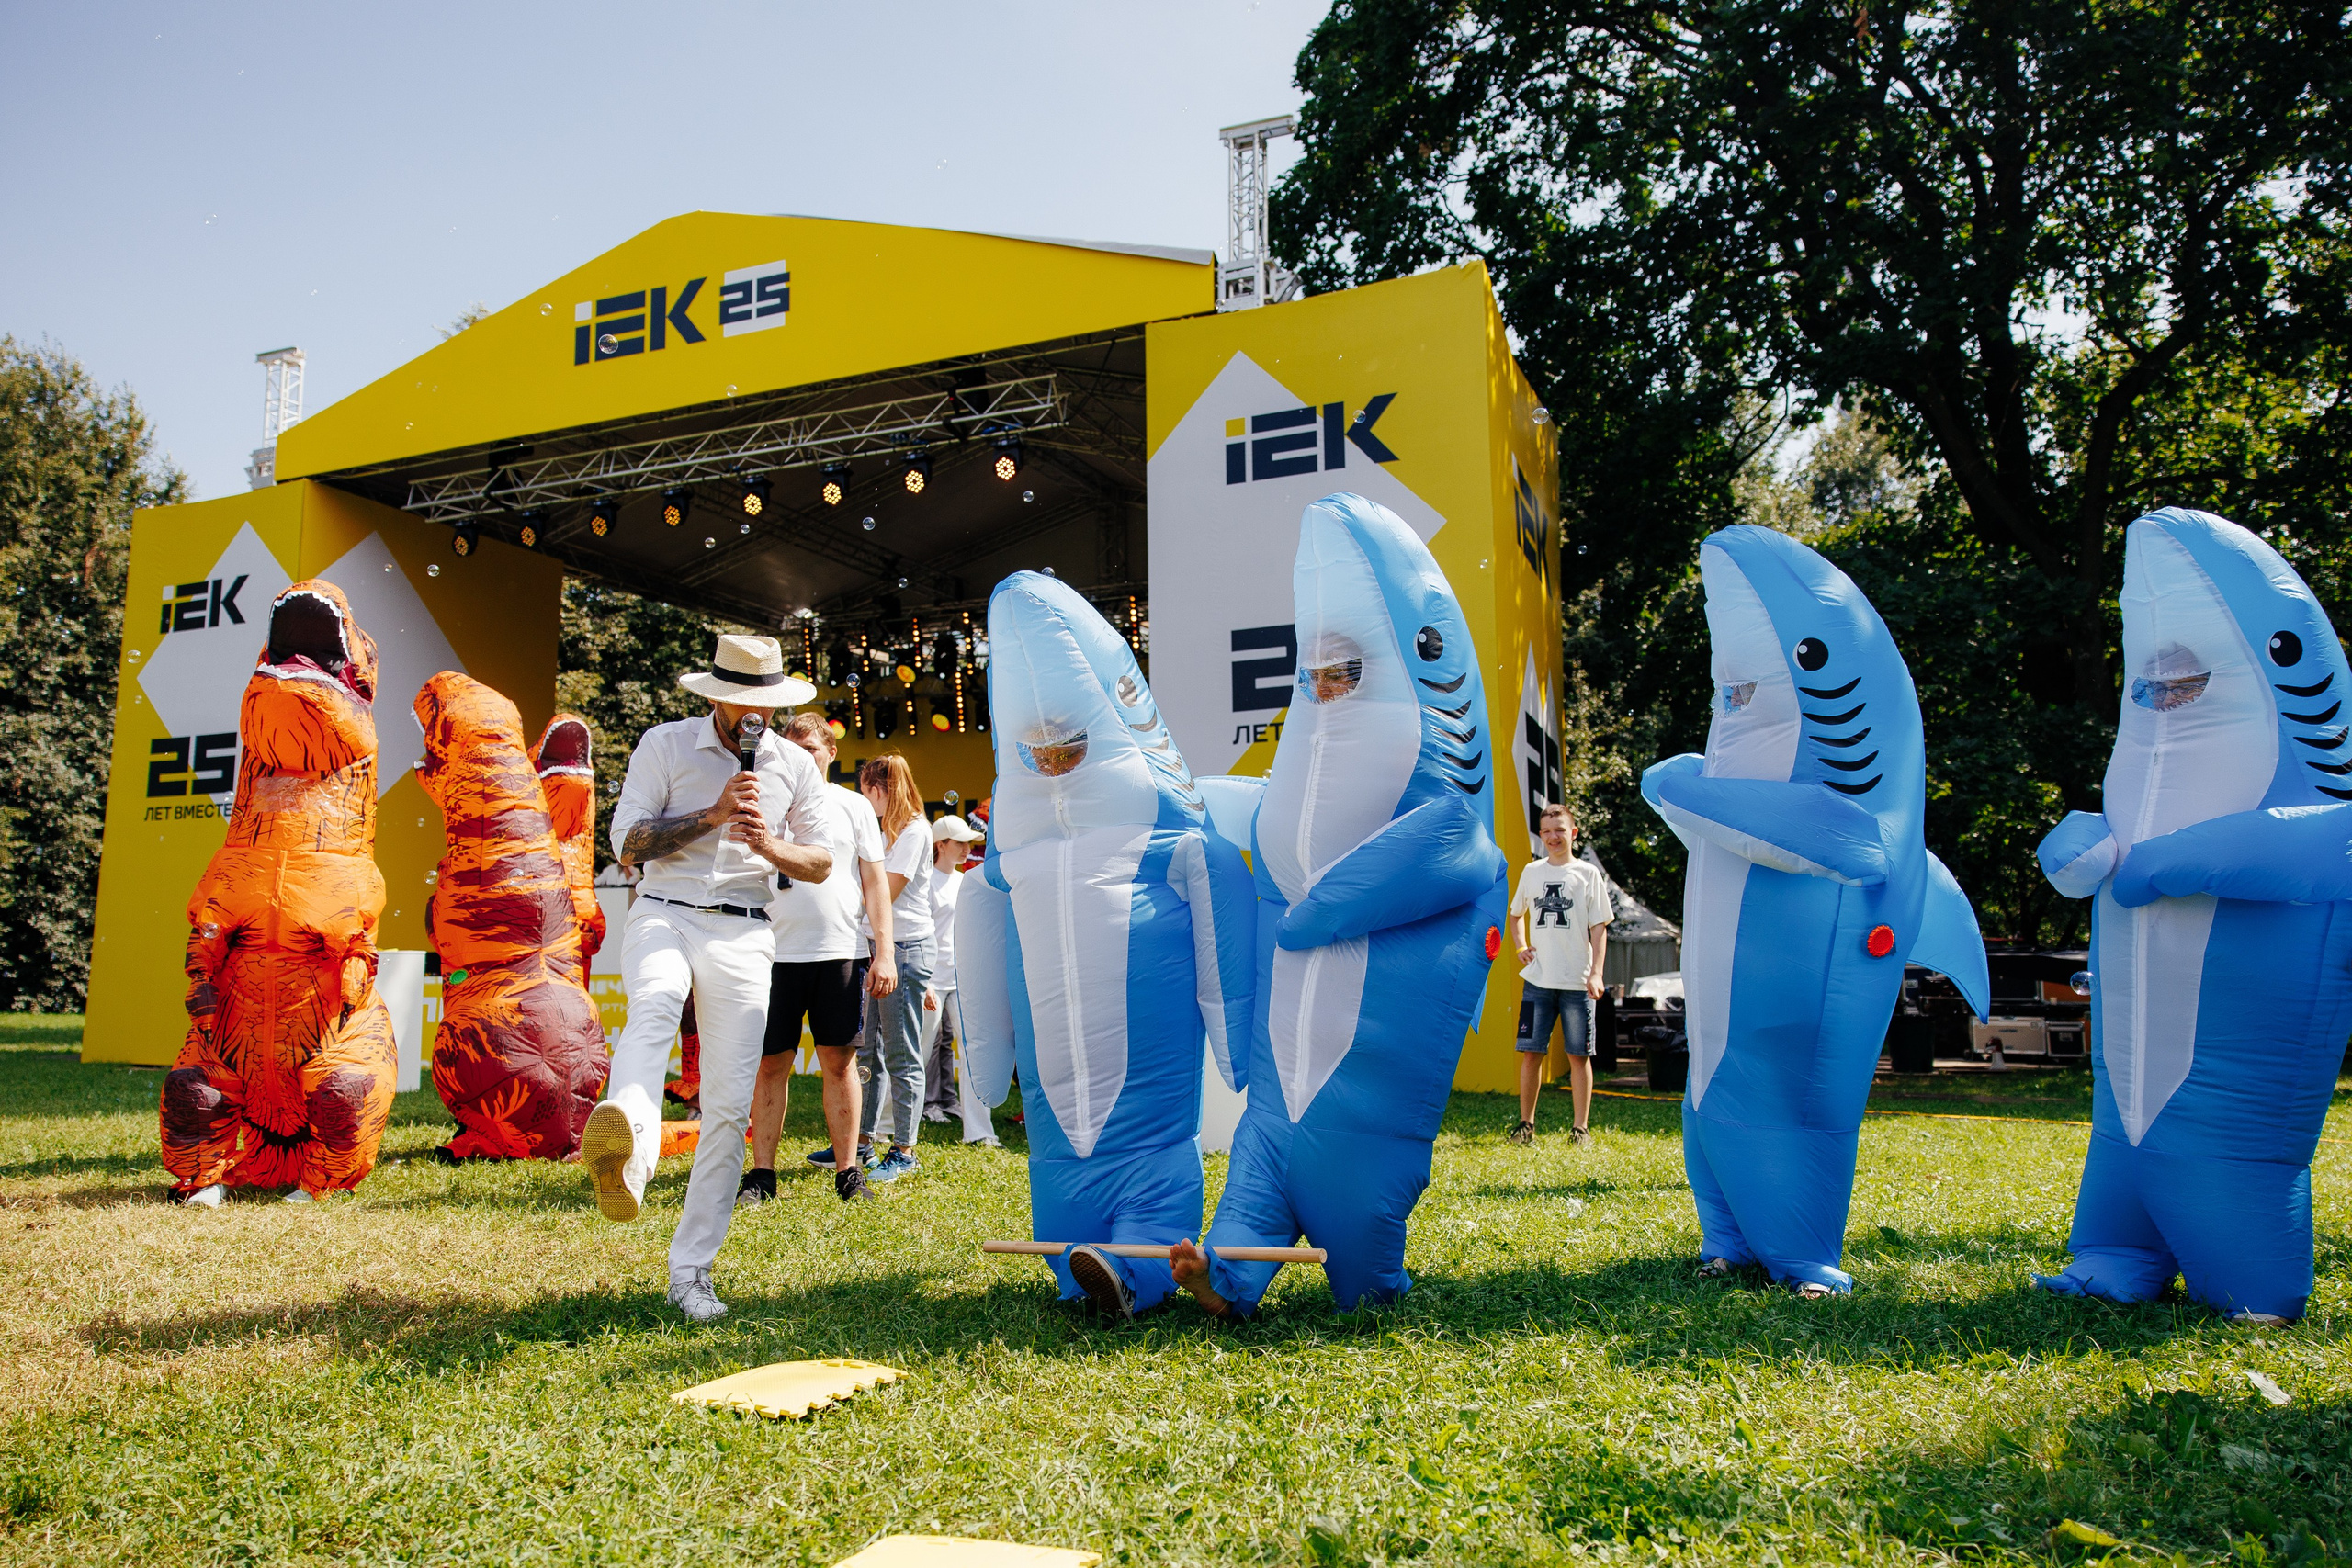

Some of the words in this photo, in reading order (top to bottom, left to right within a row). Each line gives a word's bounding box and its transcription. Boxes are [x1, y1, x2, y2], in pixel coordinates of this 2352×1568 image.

[719, 271, 791, 325] 25
[1232, 722, 1285, 745] ЛЕТ
[147, 732, 237, 797] 25
[144, 807, 172, 821] ЛЕТ
[175, 803, 232, 820] ВМЕСТЕ
